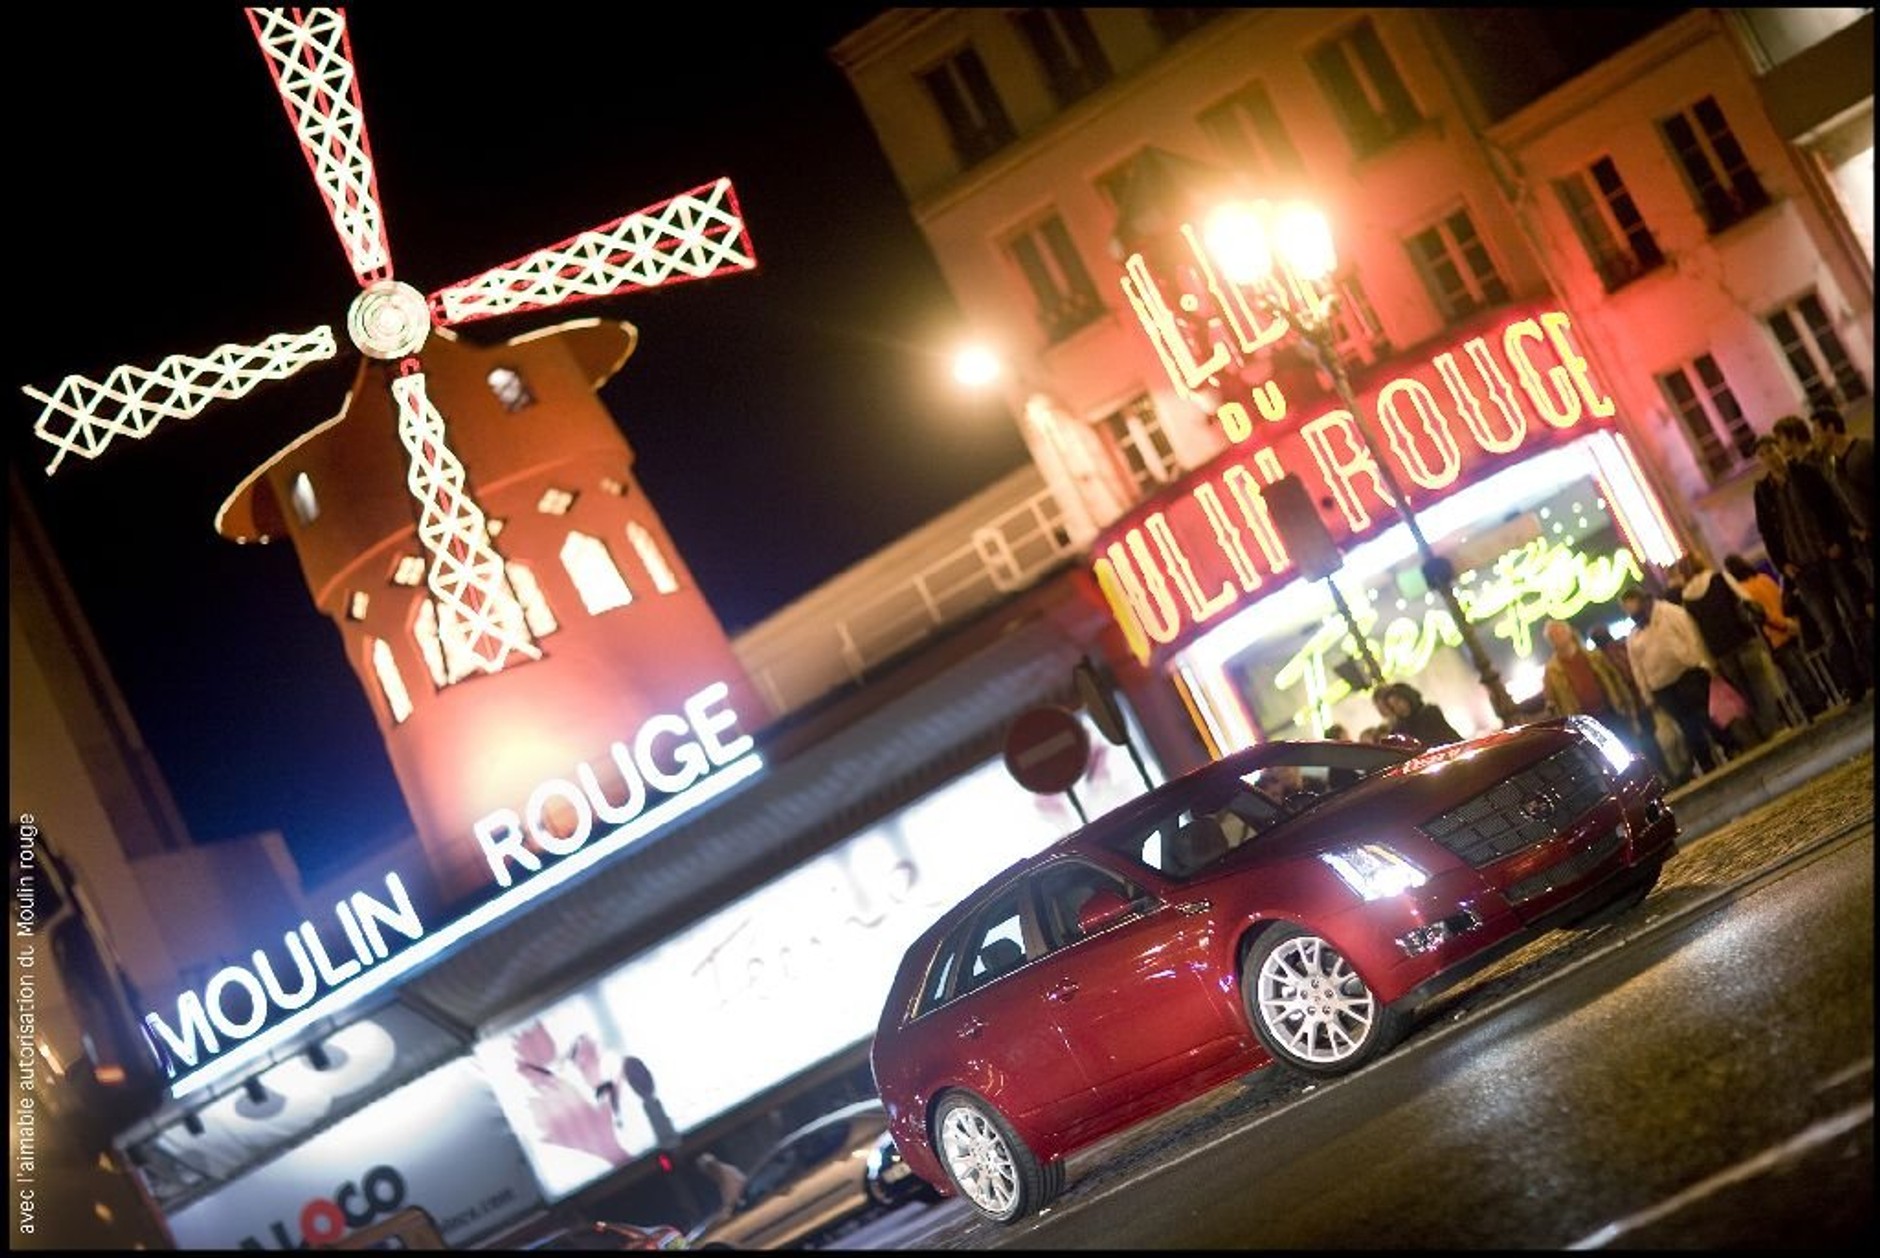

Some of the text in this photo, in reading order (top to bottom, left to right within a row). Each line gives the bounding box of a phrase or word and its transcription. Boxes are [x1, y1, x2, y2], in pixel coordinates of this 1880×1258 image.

[1217, 380, 1287, 444] DU
[1300, 311, 1615, 532] ROUGE
[141, 681, 754, 1078] MOULIN ROUGE
